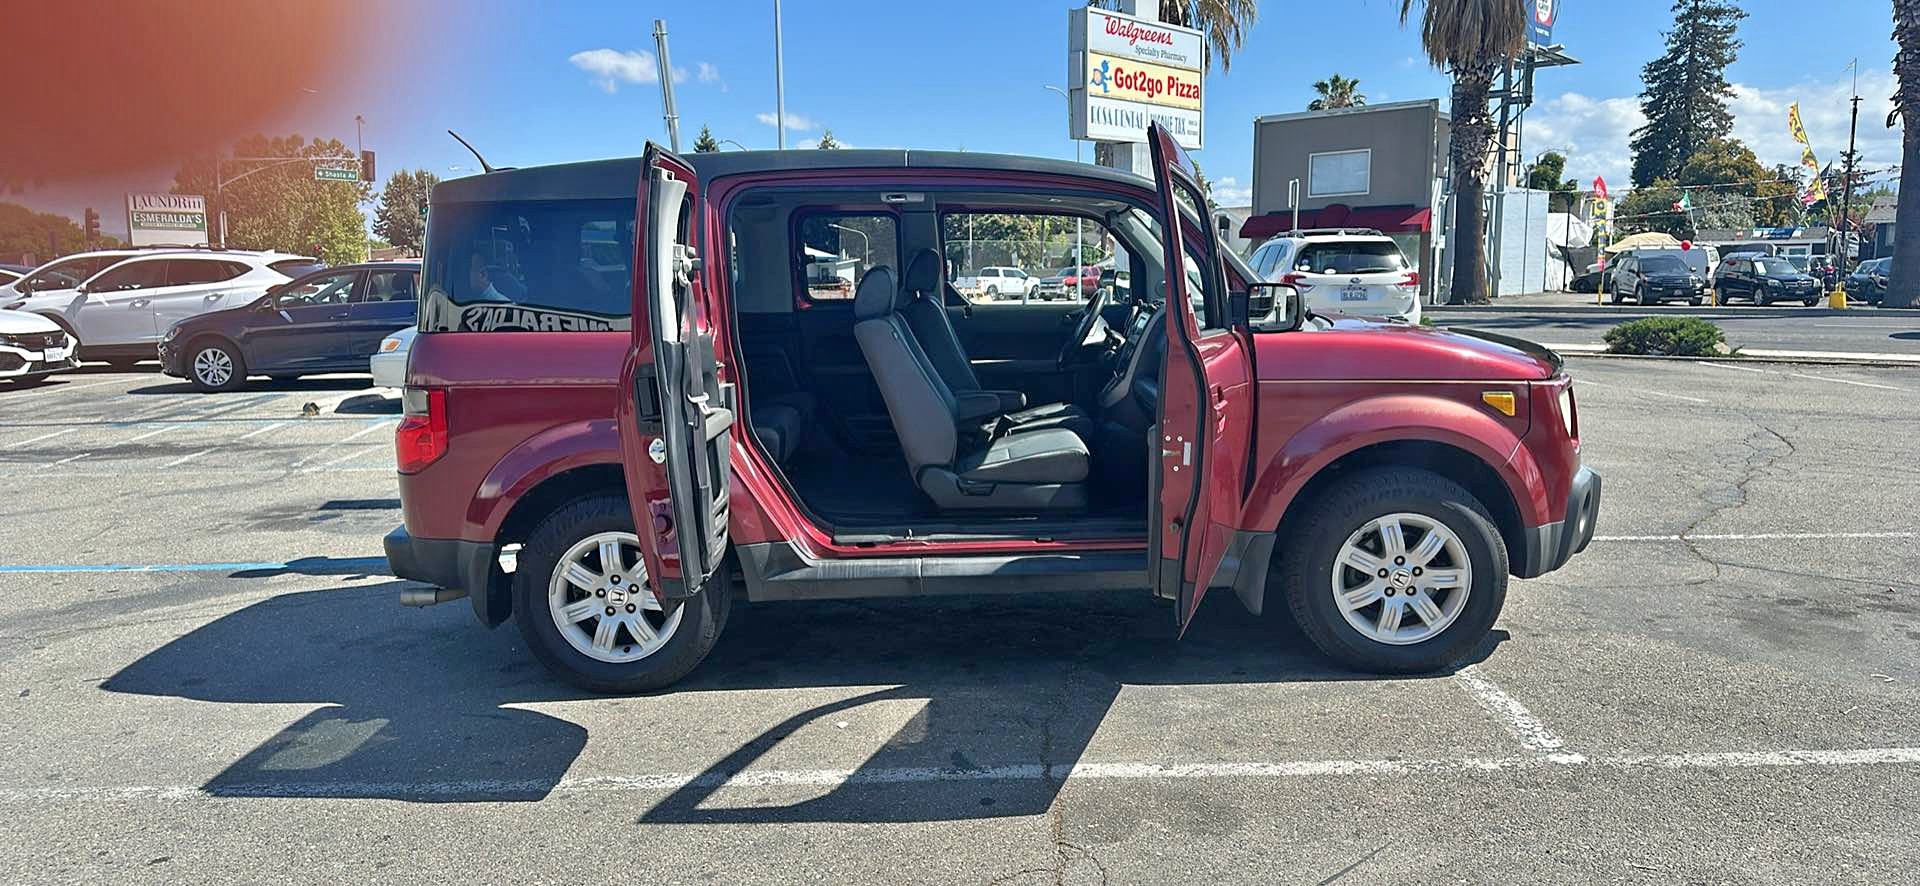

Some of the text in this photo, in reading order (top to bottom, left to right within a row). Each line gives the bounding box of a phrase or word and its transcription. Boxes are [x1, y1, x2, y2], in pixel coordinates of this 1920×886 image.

[1105, 16, 1173, 46] Walgreens
[1135, 45, 1187, 64] Specialty Pharmacy
[1114, 67, 1200, 100] Got2go Pizza
[133, 212, 203, 224] ESMERALDA'S
